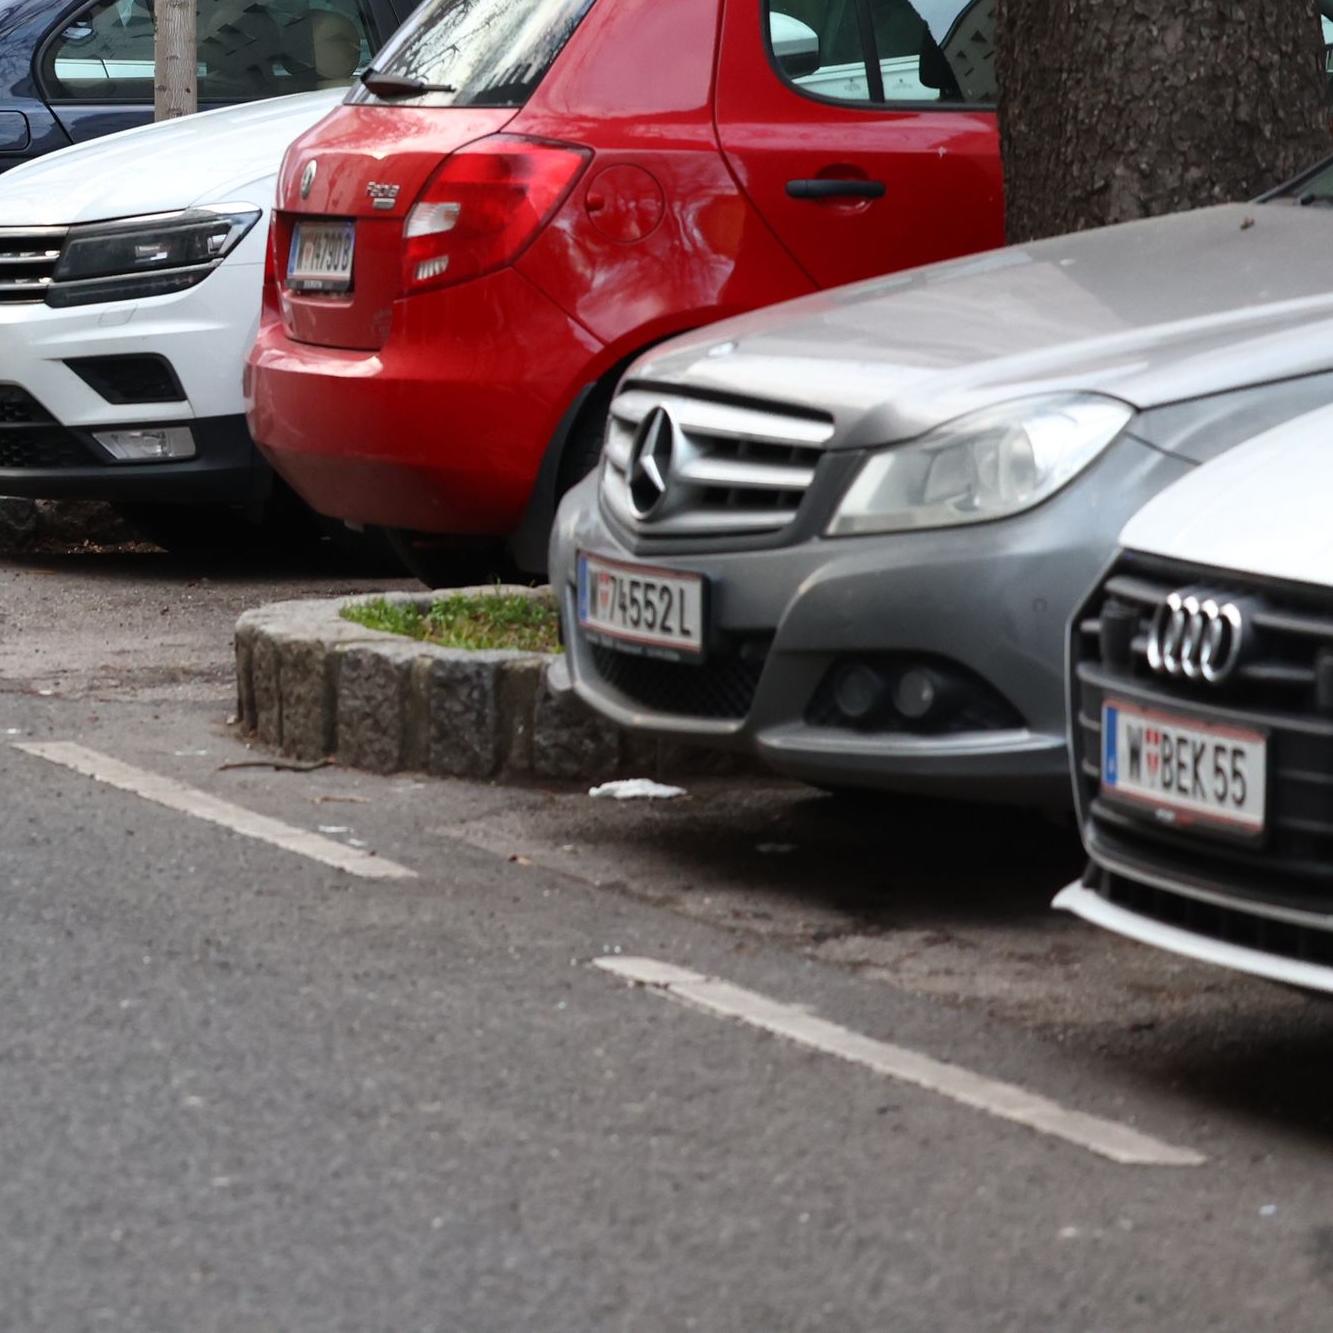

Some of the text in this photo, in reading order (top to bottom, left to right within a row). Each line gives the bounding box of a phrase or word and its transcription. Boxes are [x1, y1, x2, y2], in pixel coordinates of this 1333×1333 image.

[1126, 723, 1247, 807] W BEK 55
